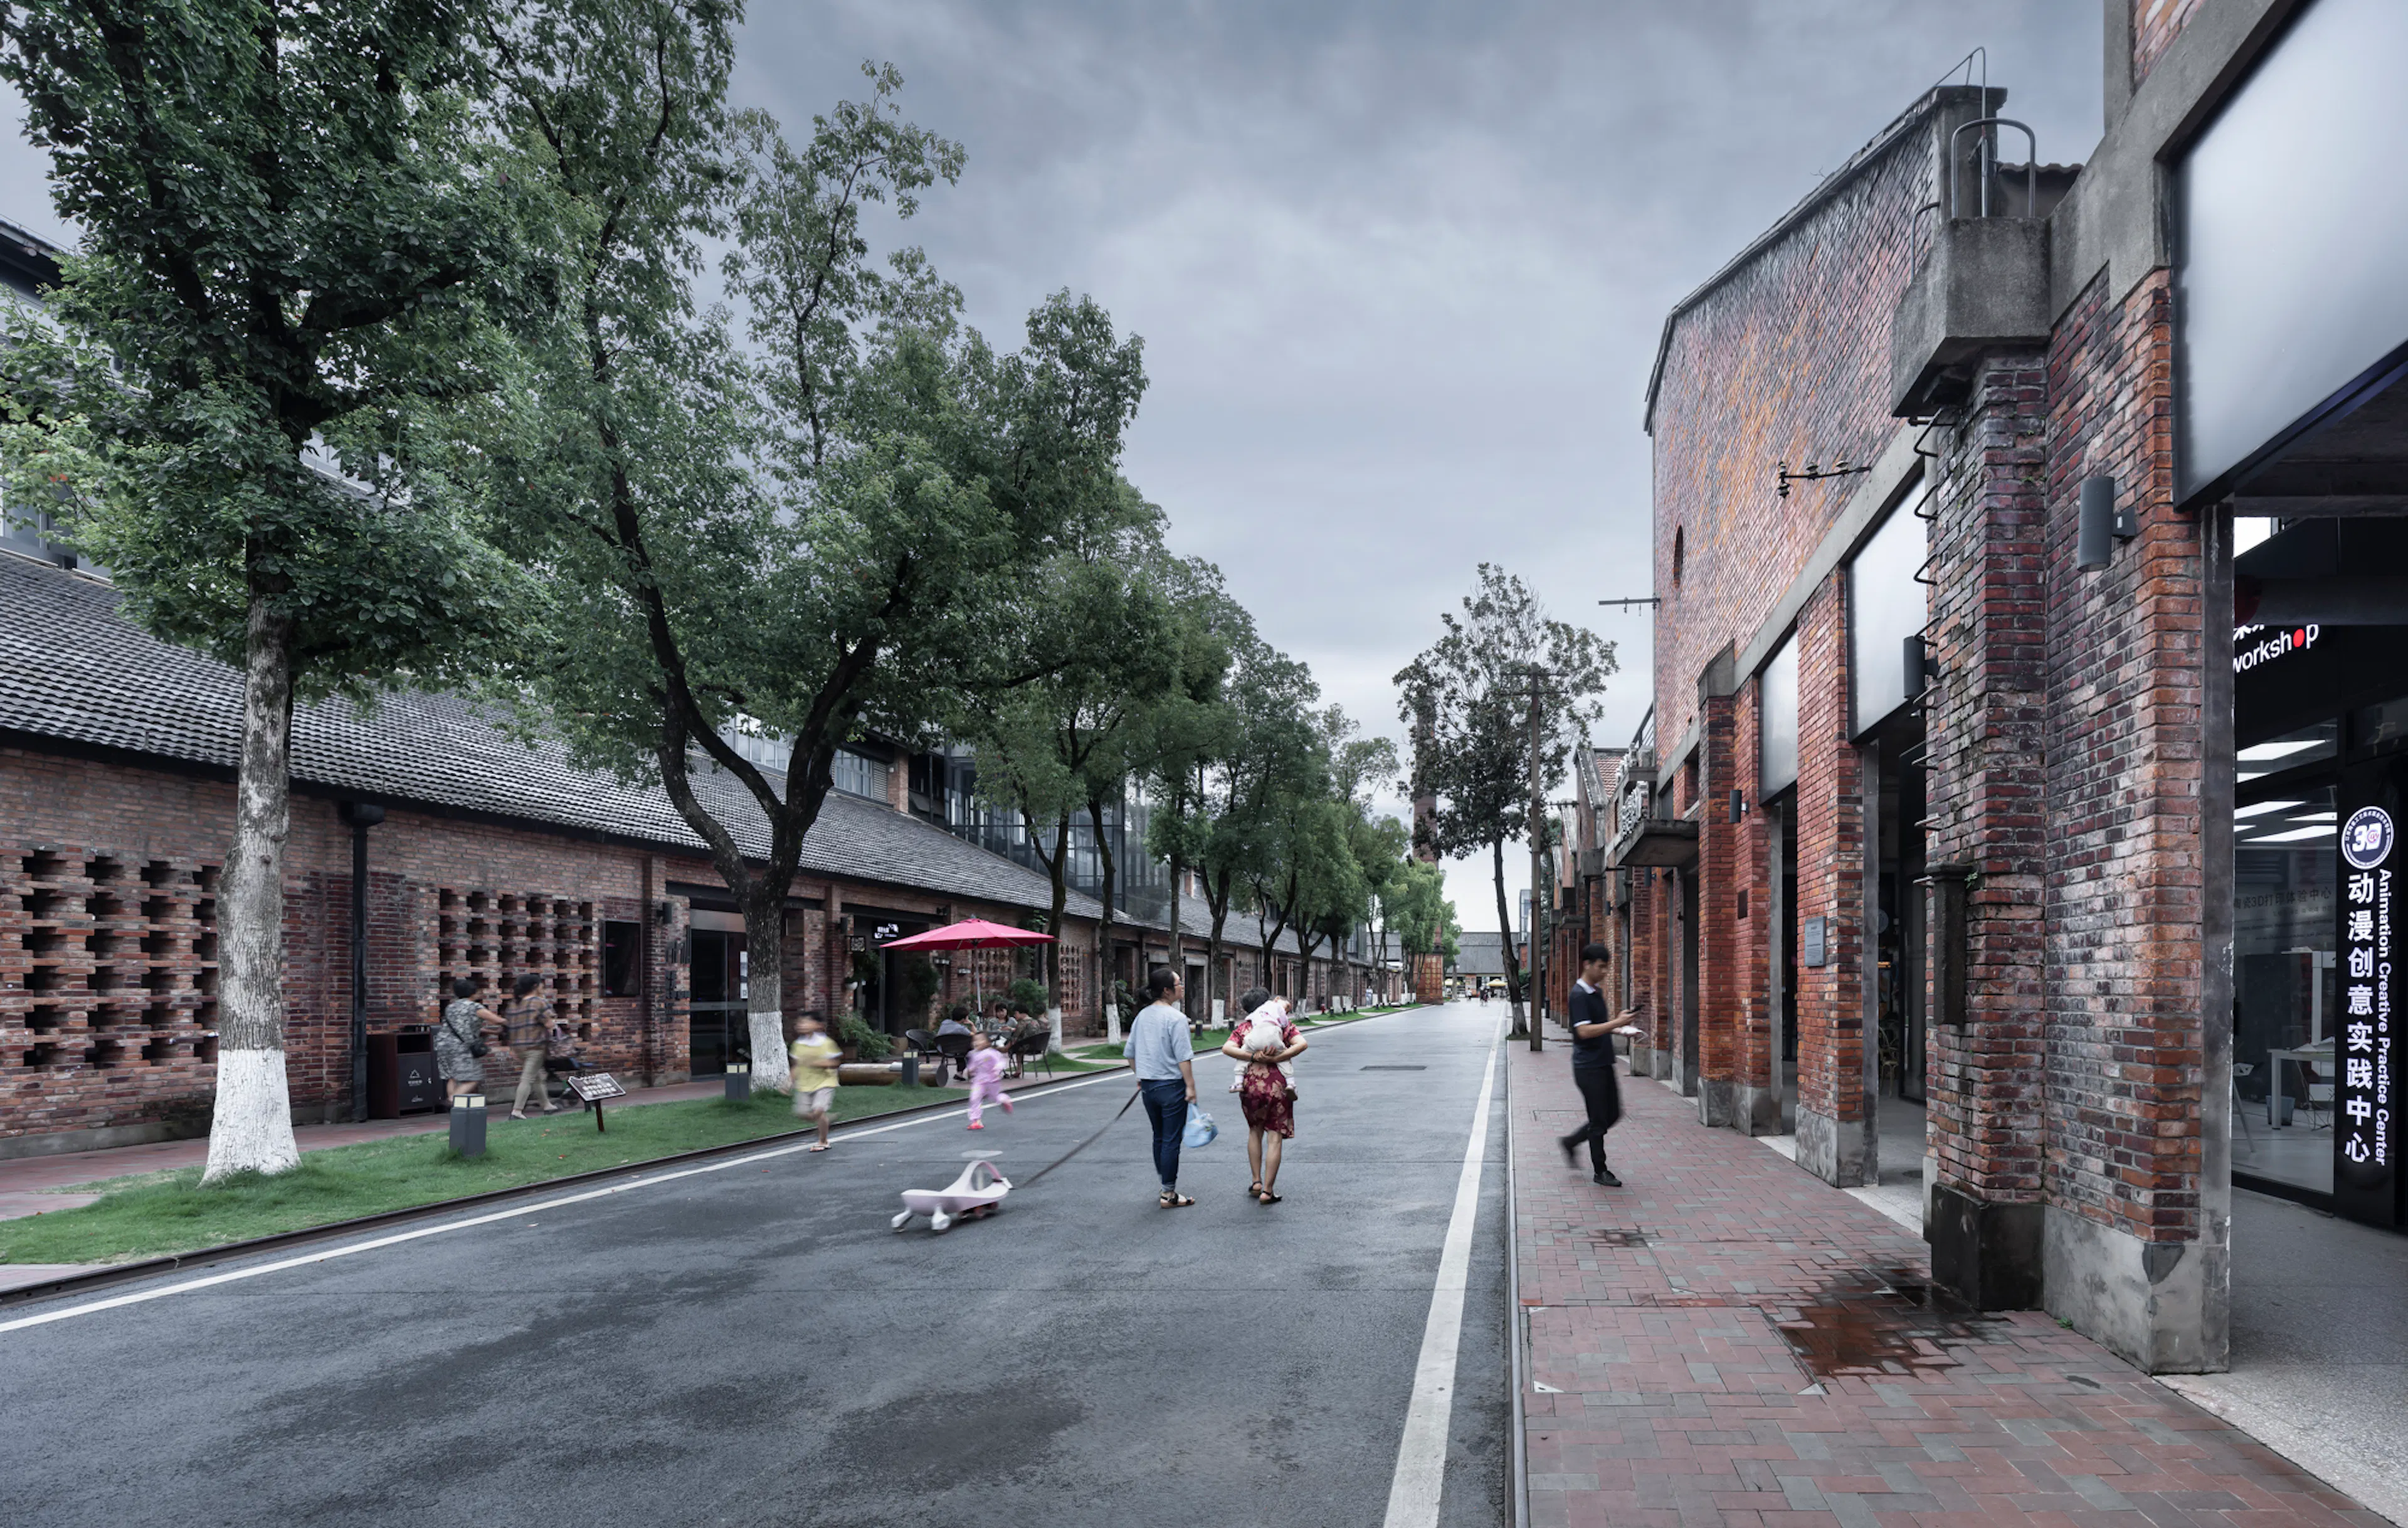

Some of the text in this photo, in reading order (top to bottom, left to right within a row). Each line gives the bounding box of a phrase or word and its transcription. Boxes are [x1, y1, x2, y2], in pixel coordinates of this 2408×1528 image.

[2232, 624, 2319, 673] workshop
[2345, 872, 2374, 1163] 动漫创意实践中心
[2375, 868, 2392, 1166] Animation Creative Practice Center
